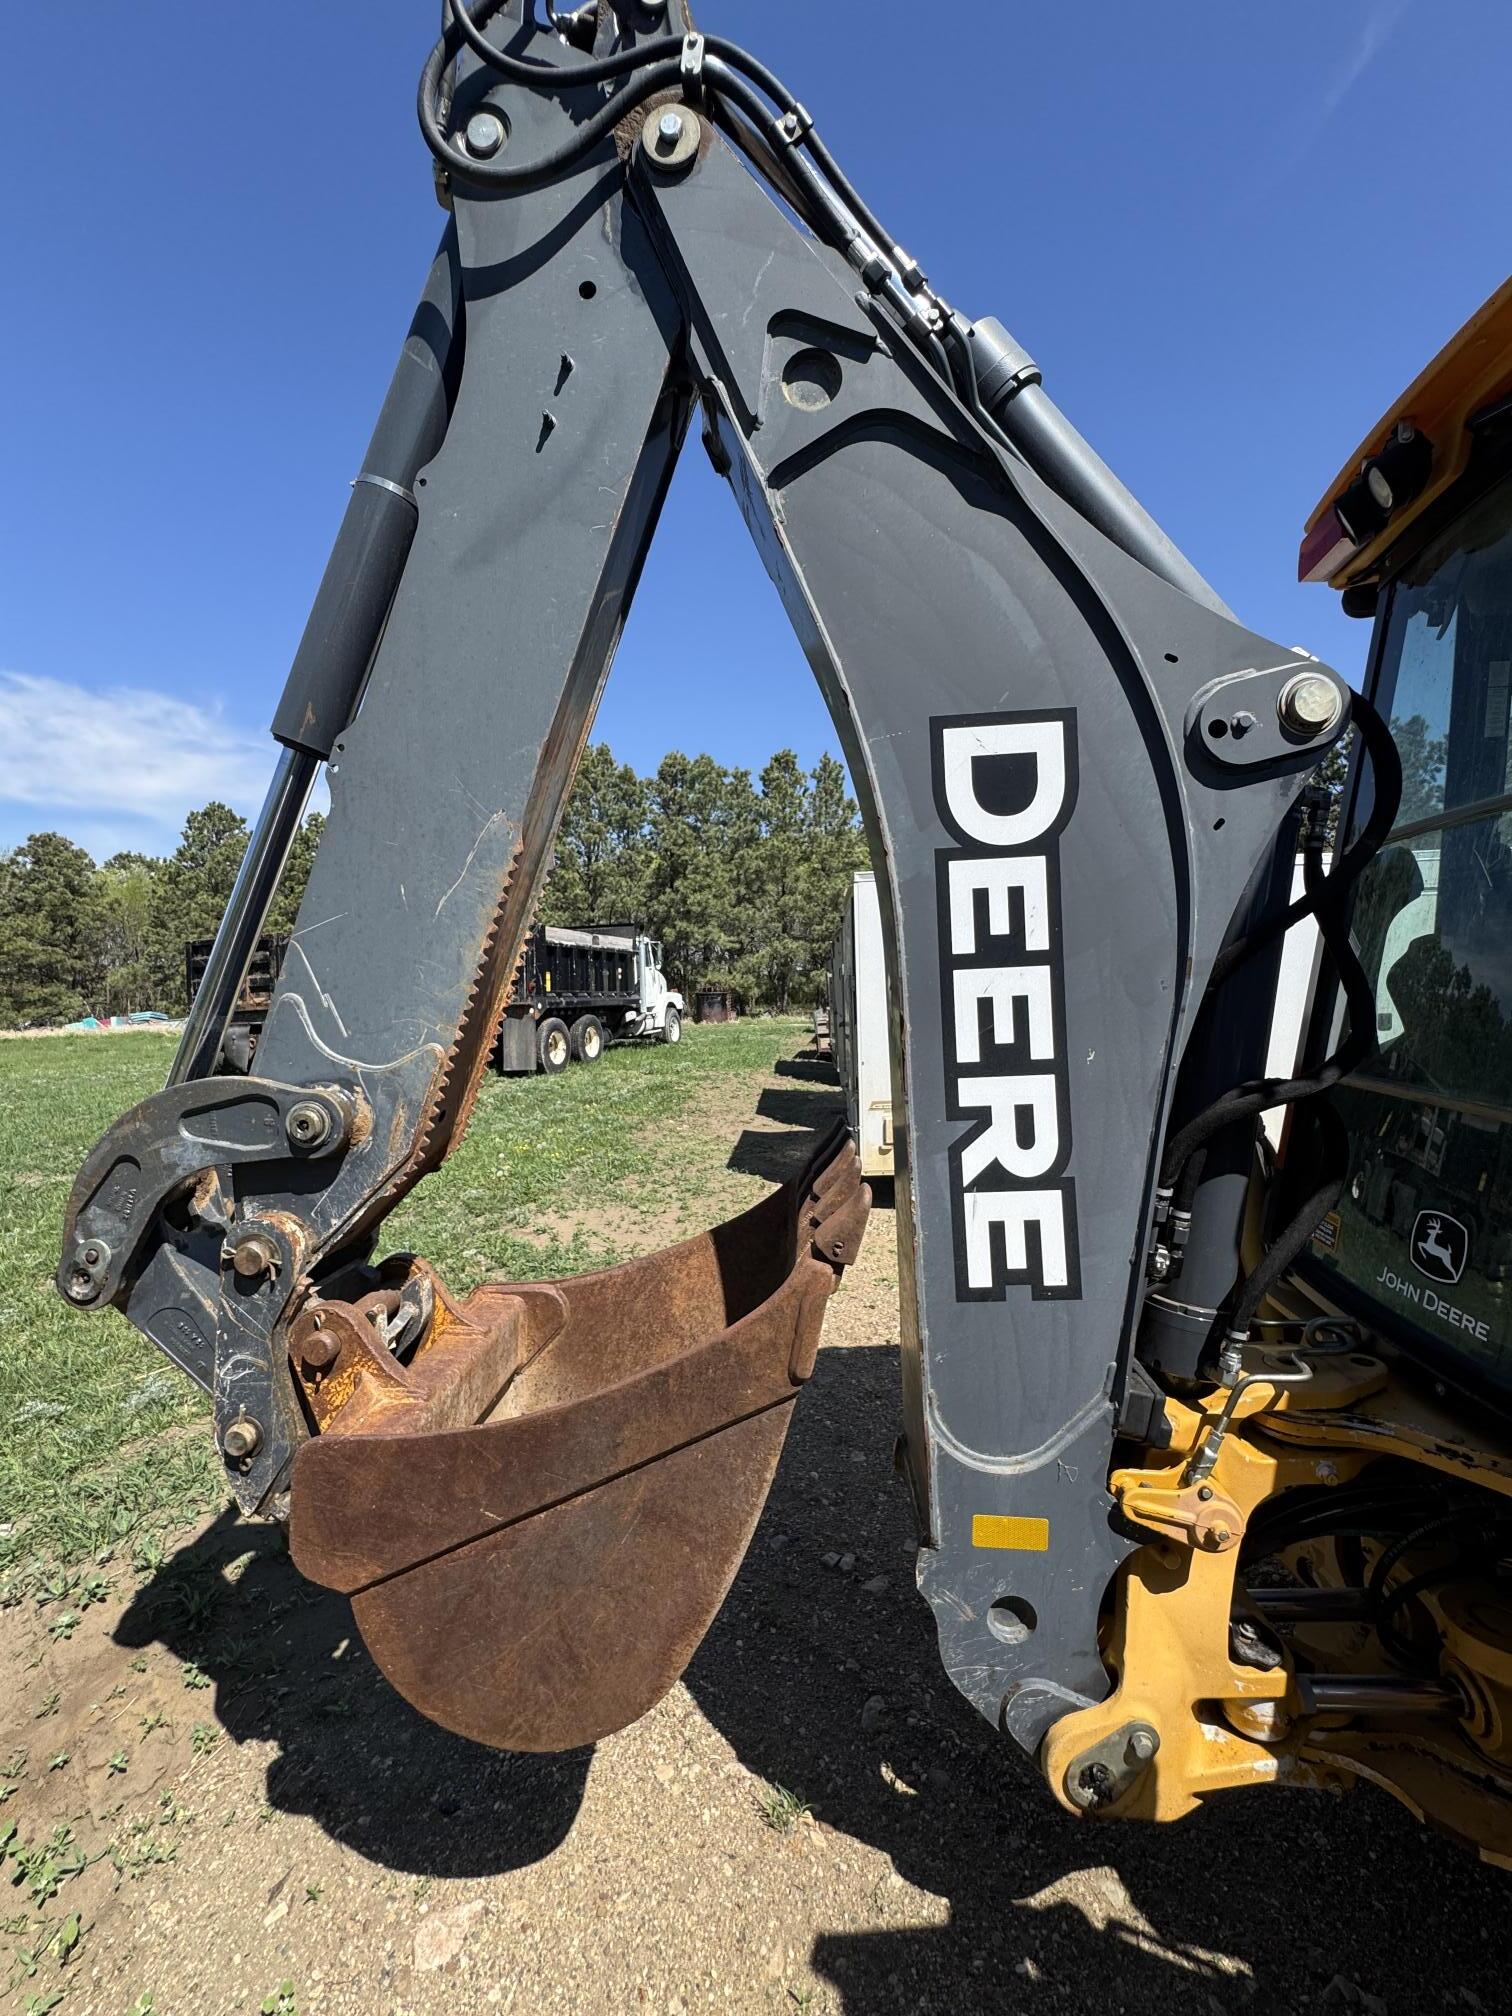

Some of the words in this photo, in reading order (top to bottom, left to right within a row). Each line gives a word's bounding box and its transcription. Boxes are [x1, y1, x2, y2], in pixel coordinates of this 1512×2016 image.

[943, 721, 1068, 1288] DEERE
[1376, 1266, 1420, 1303] JOHN
[1422, 1289, 1490, 1342] DEERE
